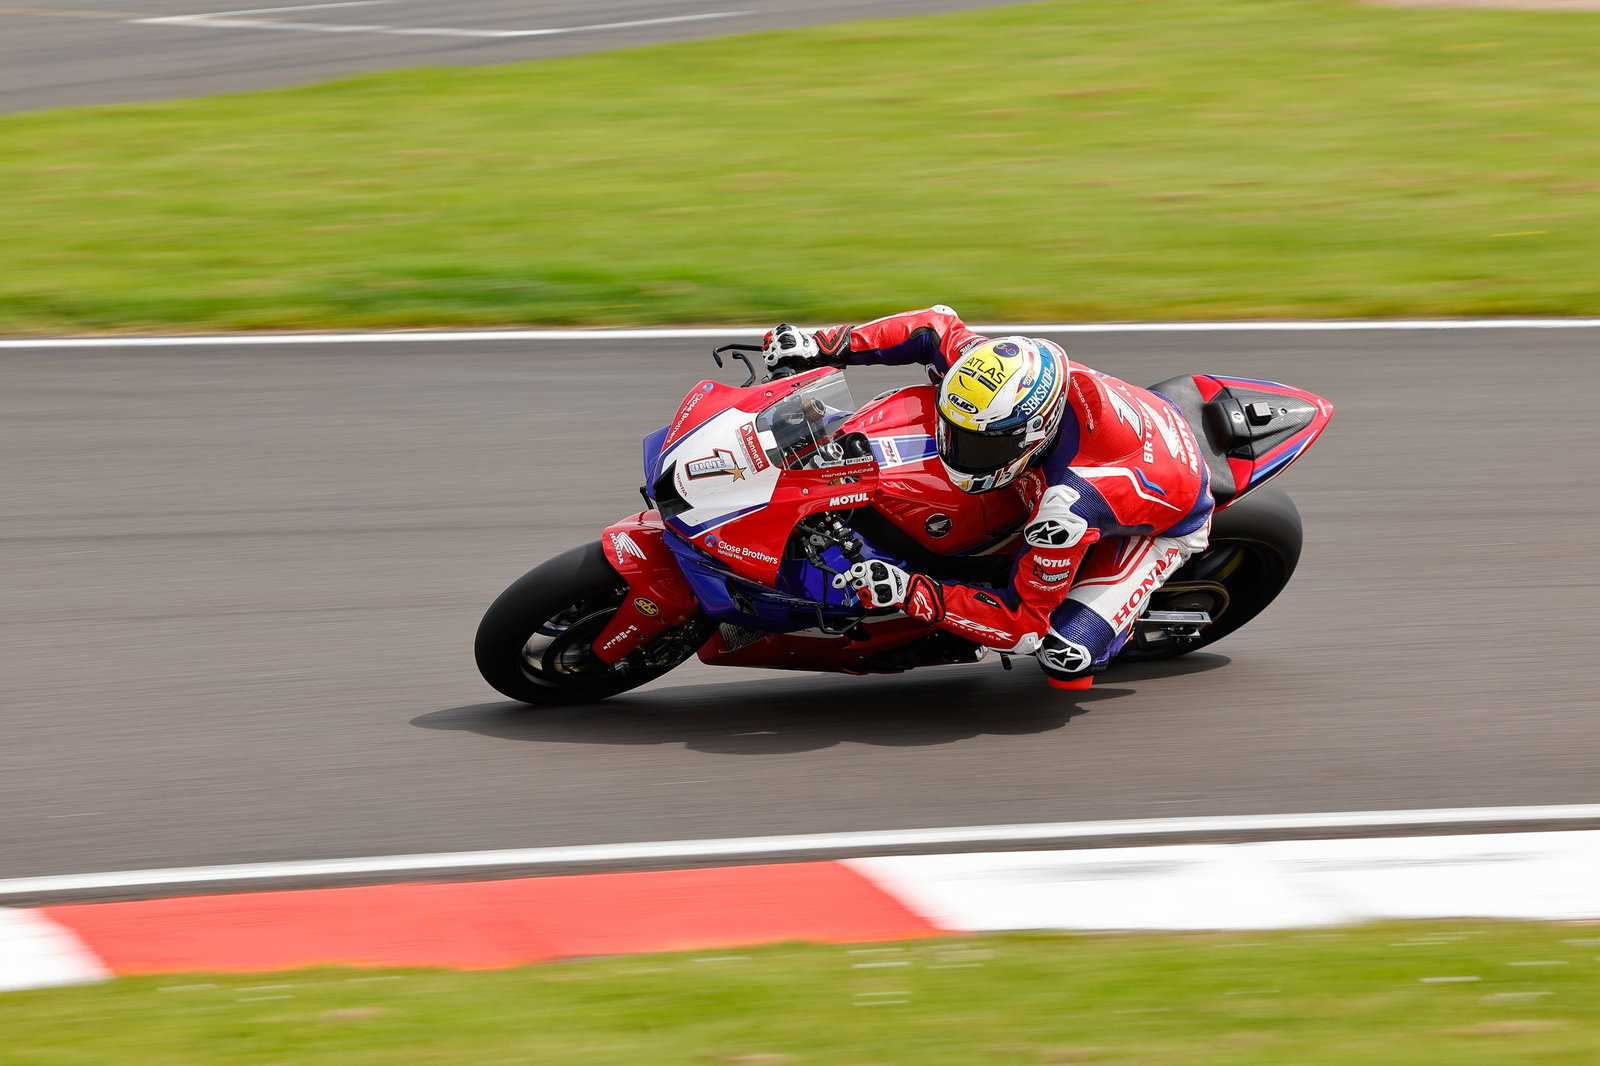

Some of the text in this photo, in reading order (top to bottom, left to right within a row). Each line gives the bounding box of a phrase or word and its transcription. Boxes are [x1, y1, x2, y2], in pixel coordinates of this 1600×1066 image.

[965, 357, 1006, 384] ATLAS
[951, 395, 973, 411] HJC
[745, 435, 764, 469] Bennetts
[847, 467, 874, 475] RACING
[829, 493, 869, 506] MOTUL
[609, 532, 624, 565] HONDA
[718, 540, 778, 564] Close Brothers
[1033, 554, 1071, 568] MOTUL
[1112, 548, 1179, 628] HONDA
[635, 599, 658, 616] sbs
